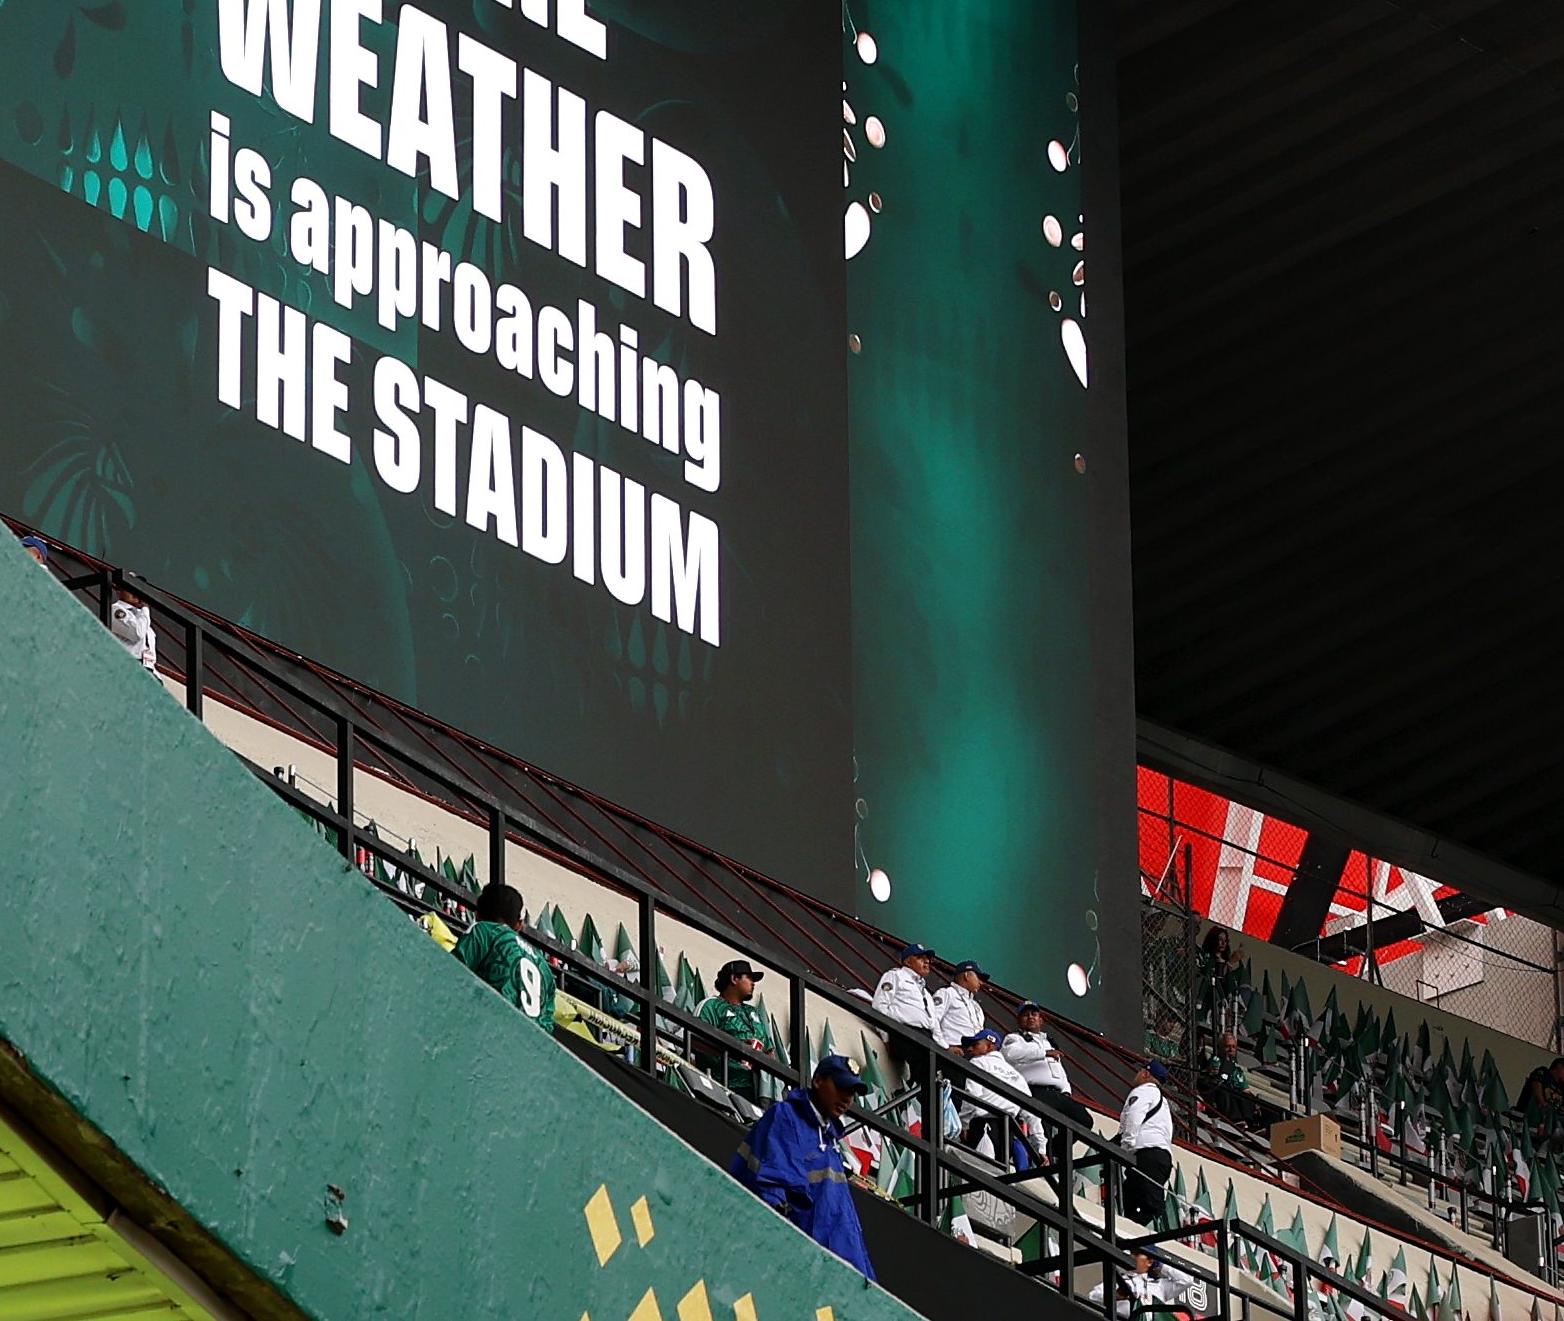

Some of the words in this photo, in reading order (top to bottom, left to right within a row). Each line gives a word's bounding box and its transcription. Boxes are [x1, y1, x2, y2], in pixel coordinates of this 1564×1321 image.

[207, 266, 351, 465] THE
[373, 356, 720, 647] STADIUM
[210, 110, 272, 241] is
[290, 177, 720, 493] approaching
[519, 956, 542, 1017] 9
